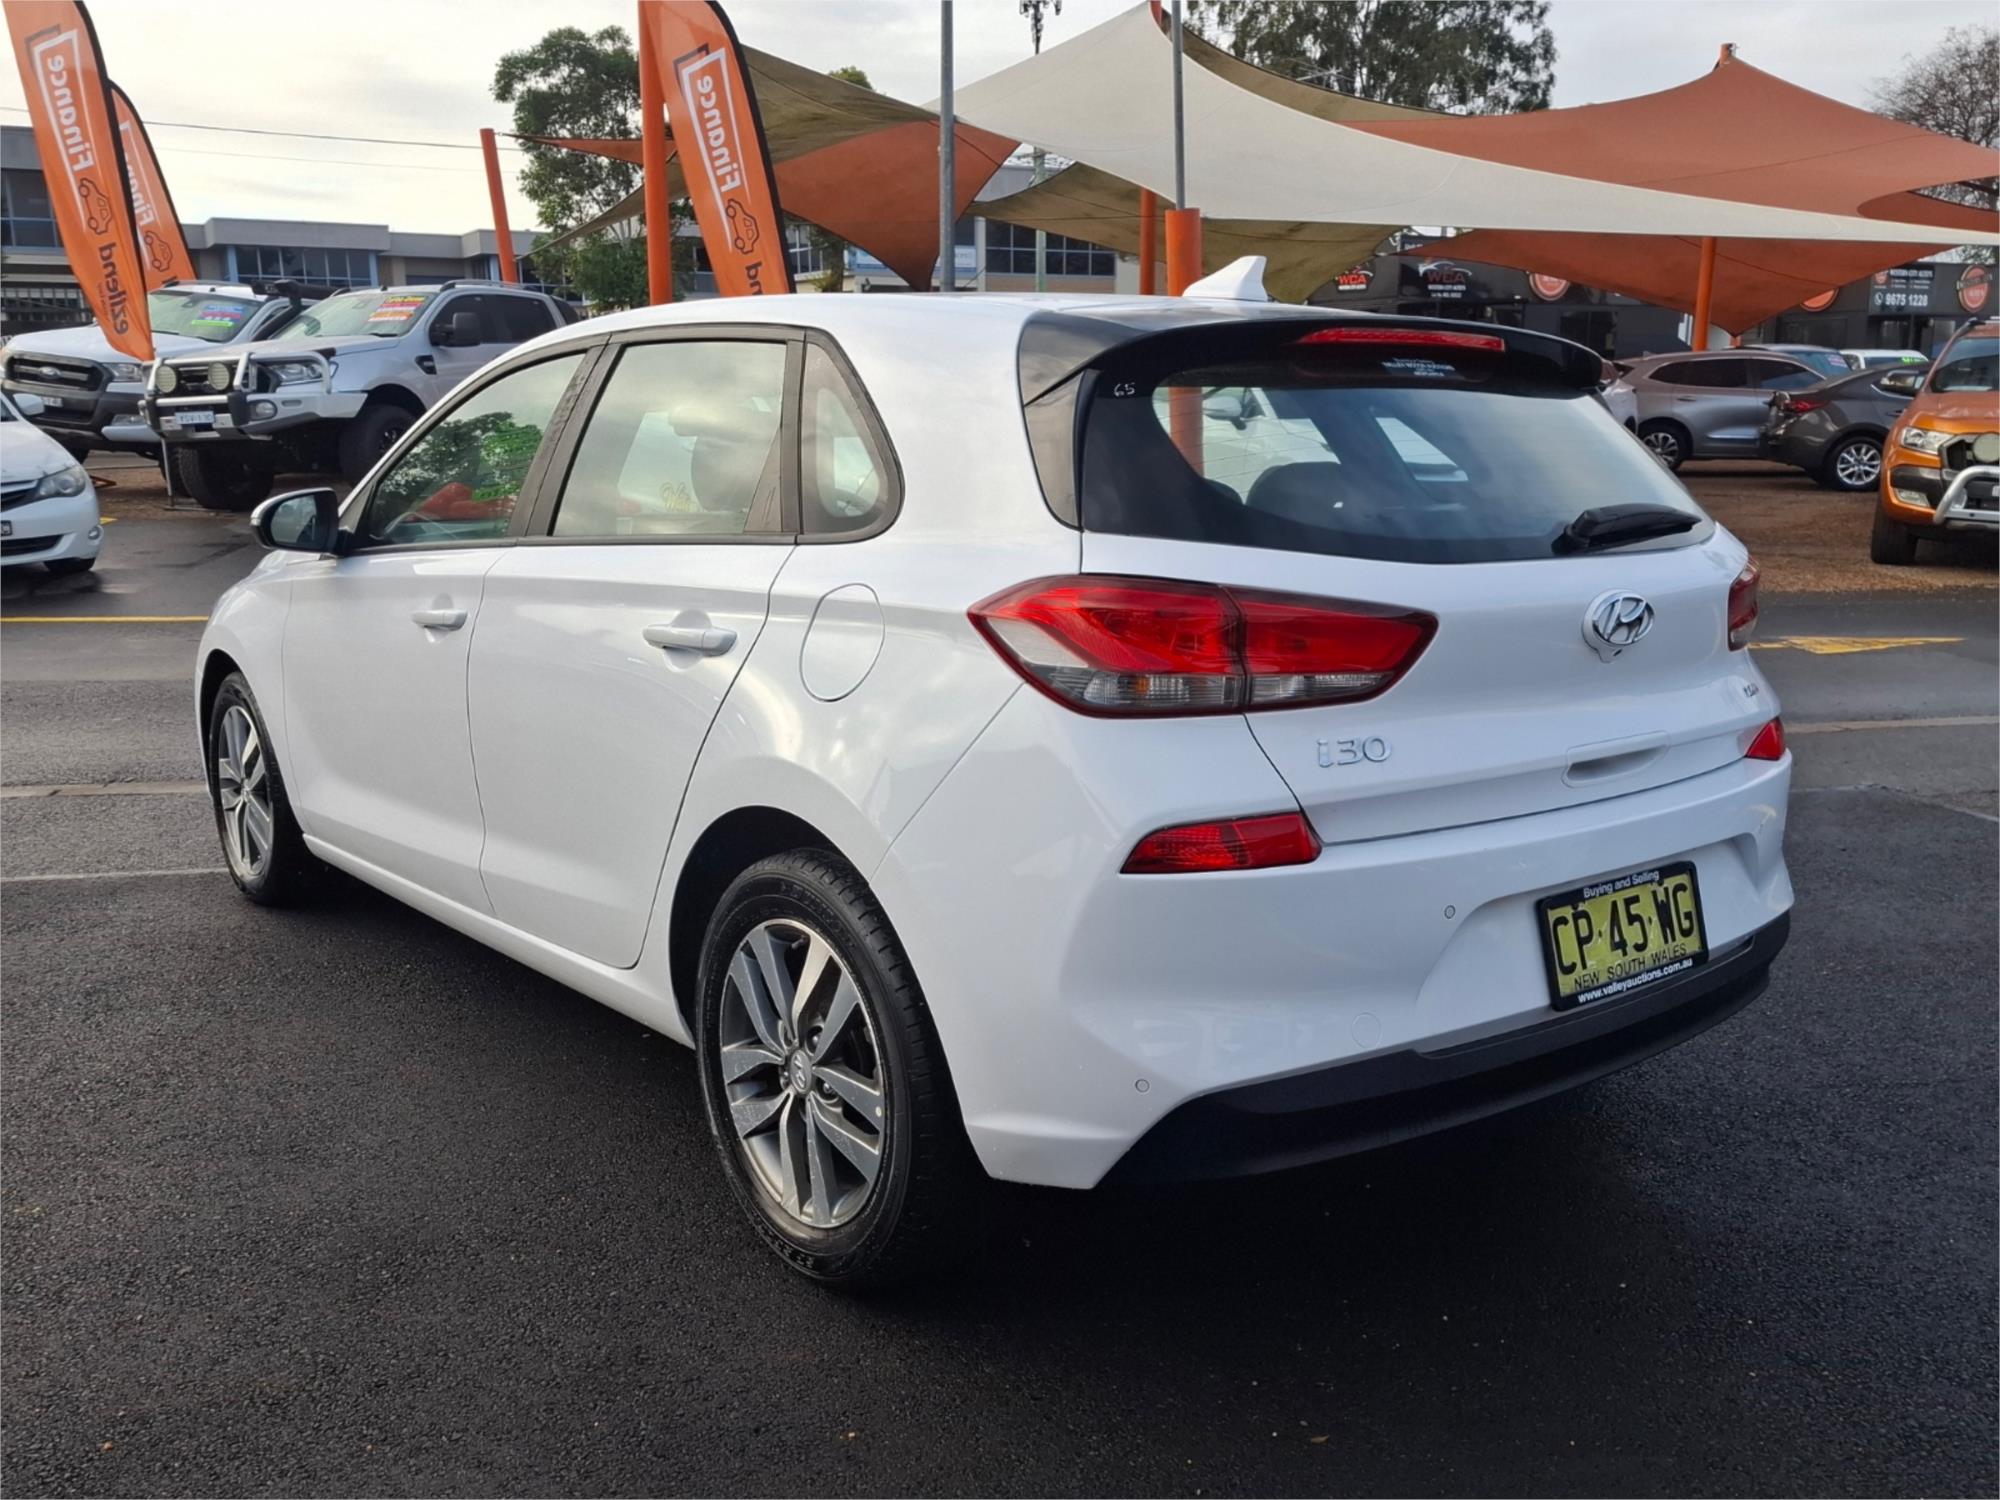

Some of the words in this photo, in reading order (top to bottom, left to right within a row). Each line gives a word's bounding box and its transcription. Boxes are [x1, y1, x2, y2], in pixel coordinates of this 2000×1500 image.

[1338, 274, 1367, 285] WCA
[1427, 271, 1466, 283] WCA
[1885, 292, 1906, 306] 9675
[1908, 293, 1928, 307] 1228
[1317, 736, 1392, 768] i30
[1583, 882, 1613, 898] Buying
[1614, 877, 1631, 890] and
[1632, 870, 1660, 886] Selling
[1574, 970, 1600, 990] NEW
[1607, 959, 1646, 980] SOUTH
[1651, 943, 1687, 964] WALES
[1577, 959, 1694, 1003] www.valleyauctions.com.au
